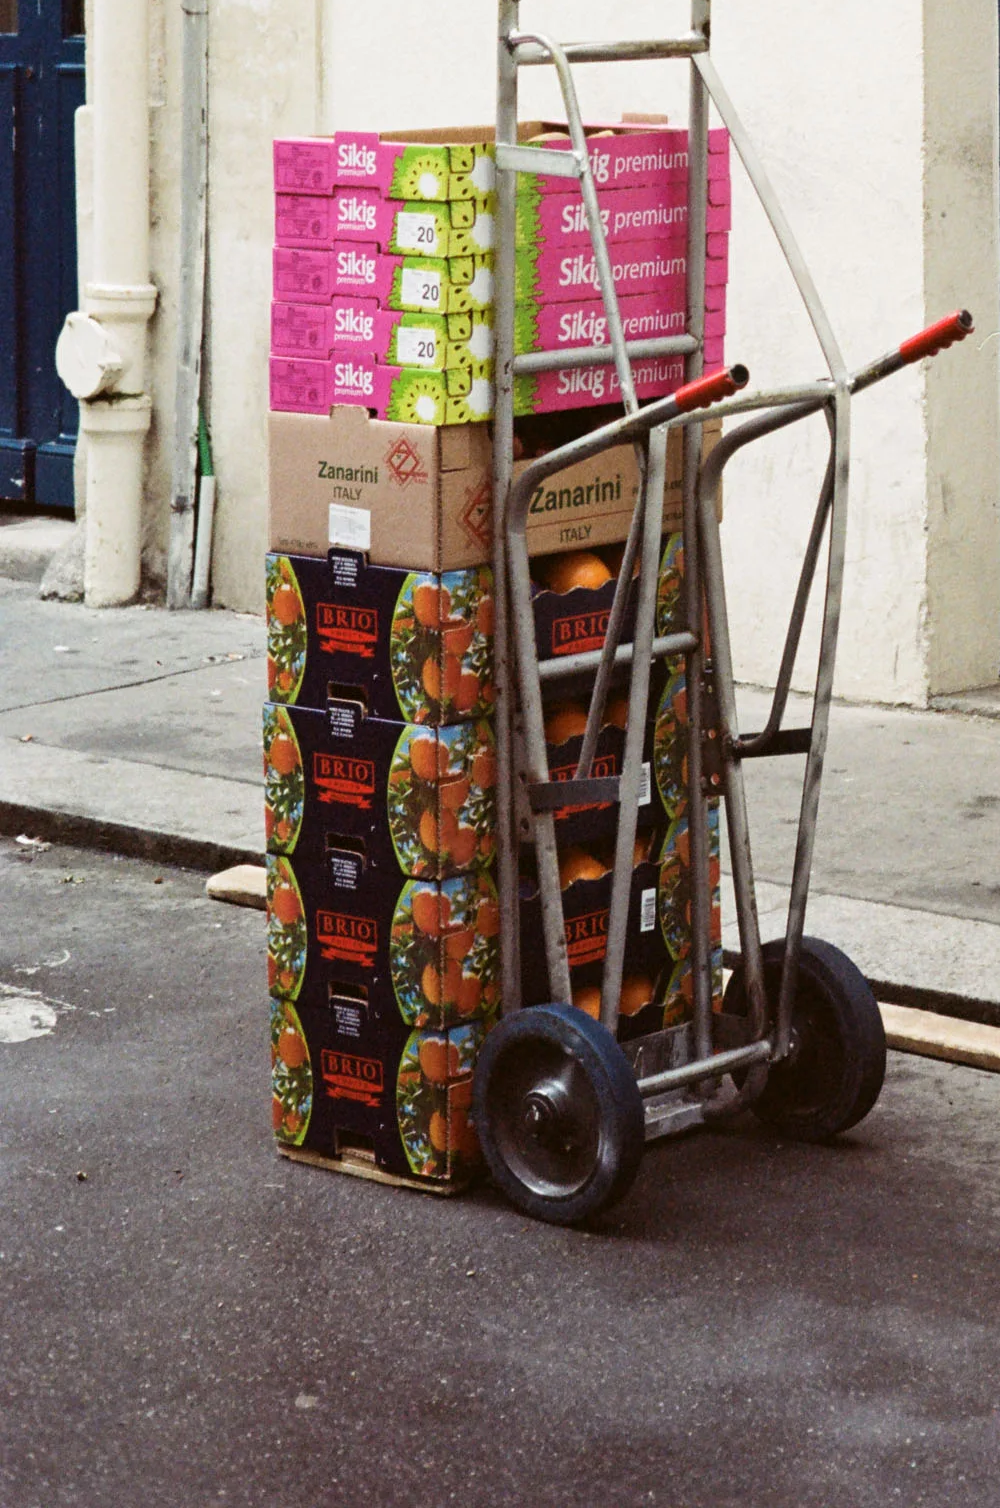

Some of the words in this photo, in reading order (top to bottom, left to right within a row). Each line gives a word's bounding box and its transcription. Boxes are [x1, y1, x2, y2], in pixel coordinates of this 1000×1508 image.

[337, 143, 376, 175] Sikig
[614, 148, 689, 180] premium
[337, 197, 376, 230] Sikig
[561, 202, 610, 237] Sikg
[614, 204, 688, 235] premium
[417, 226, 435, 243] 20
[336, 251, 376, 284] Sikig
[422, 283, 439, 301] 20
[335, 308, 374, 341] Sikig
[558, 310, 607, 345] Sikig
[622, 310, 685, 334] remium
[417, 341, 435, 358] 20
[334, 362, 373, 395] Sikig
[557, 366, 605, 398] Sikig
[318, 460, 379, 484] Zanarini
[333, 486, 362, 501] ITALY
[530, 474, 621, 514] Zanarini
[559, 525, 592, 543] ITALY
[323, 607, 371, 630] BRIO
[321, 758, 368, 781] BRIO
[323, 915, 371, 940] BRIO
[328, 1055, 376, 1080] BRIO
